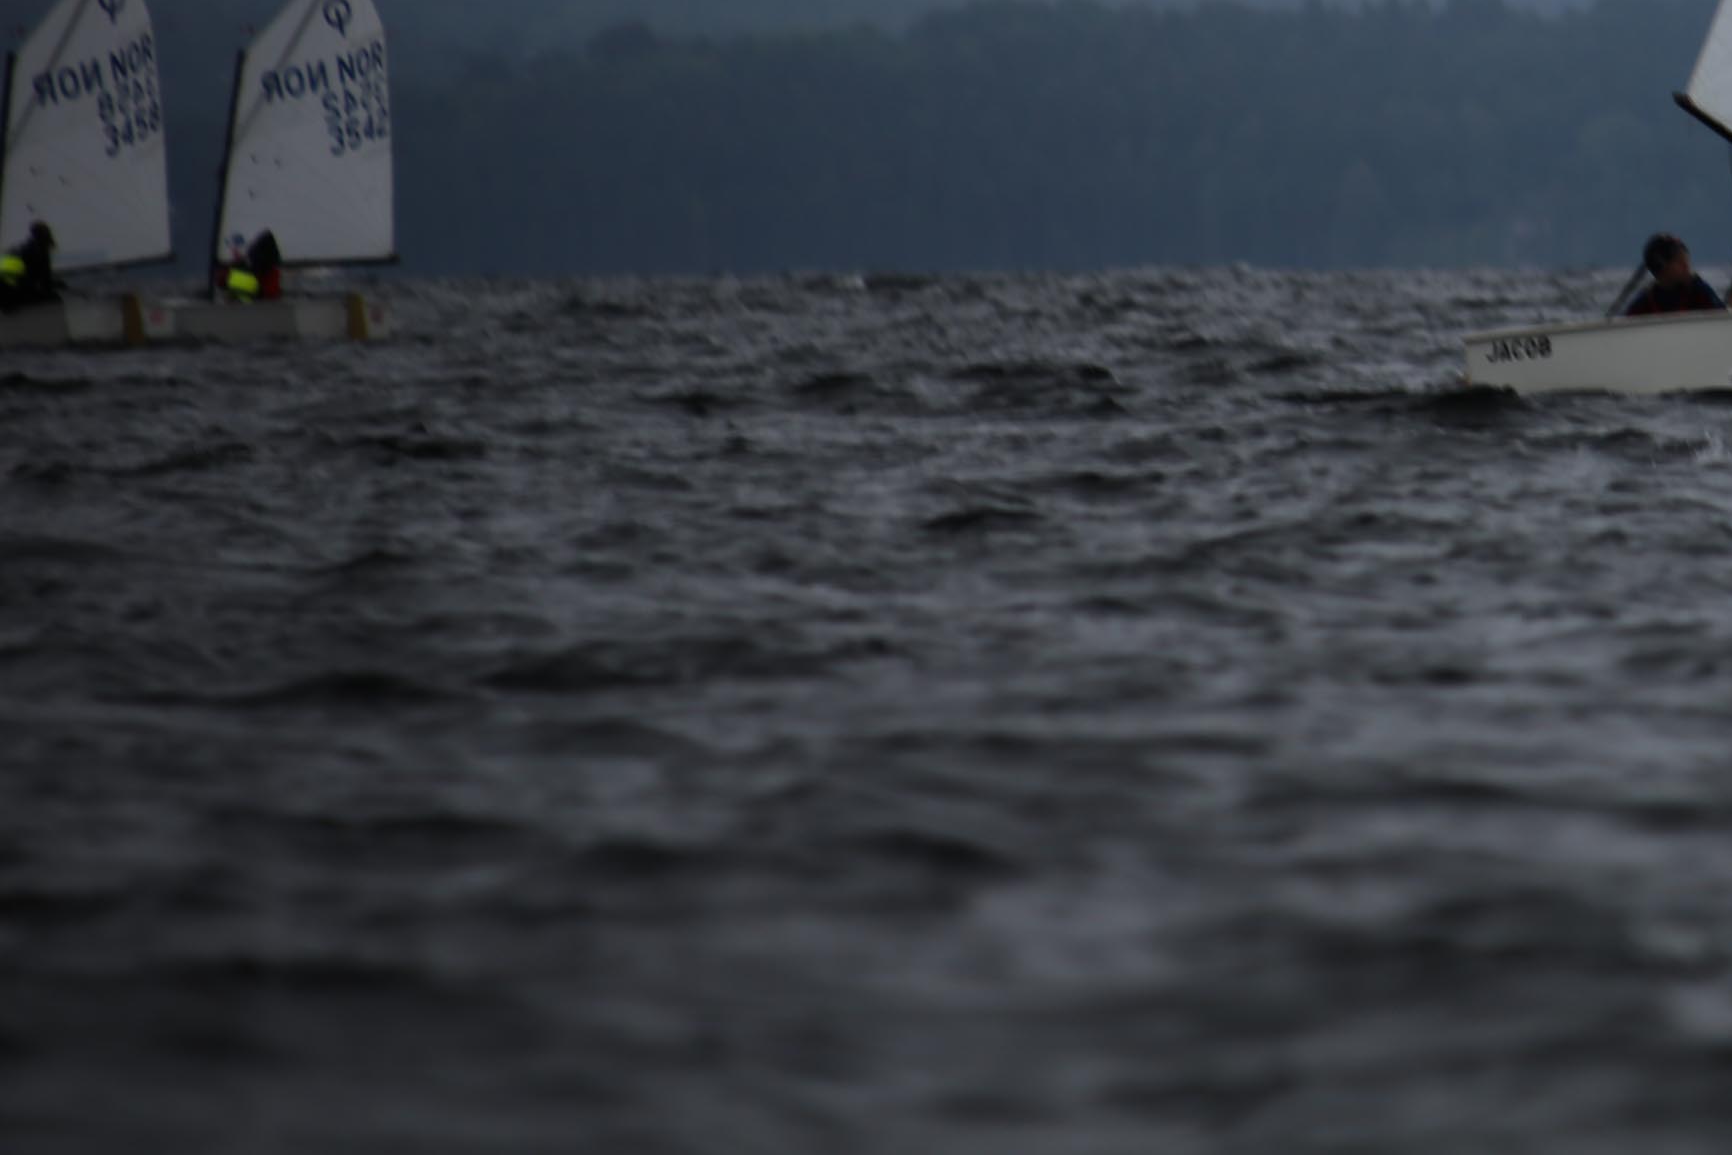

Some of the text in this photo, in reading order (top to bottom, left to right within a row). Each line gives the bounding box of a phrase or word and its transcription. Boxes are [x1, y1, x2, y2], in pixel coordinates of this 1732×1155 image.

[109, 32, 154, 87] NOR
[336, 39, 384, 86] NOR
[1485, 334, 1552, 363] JACOB
